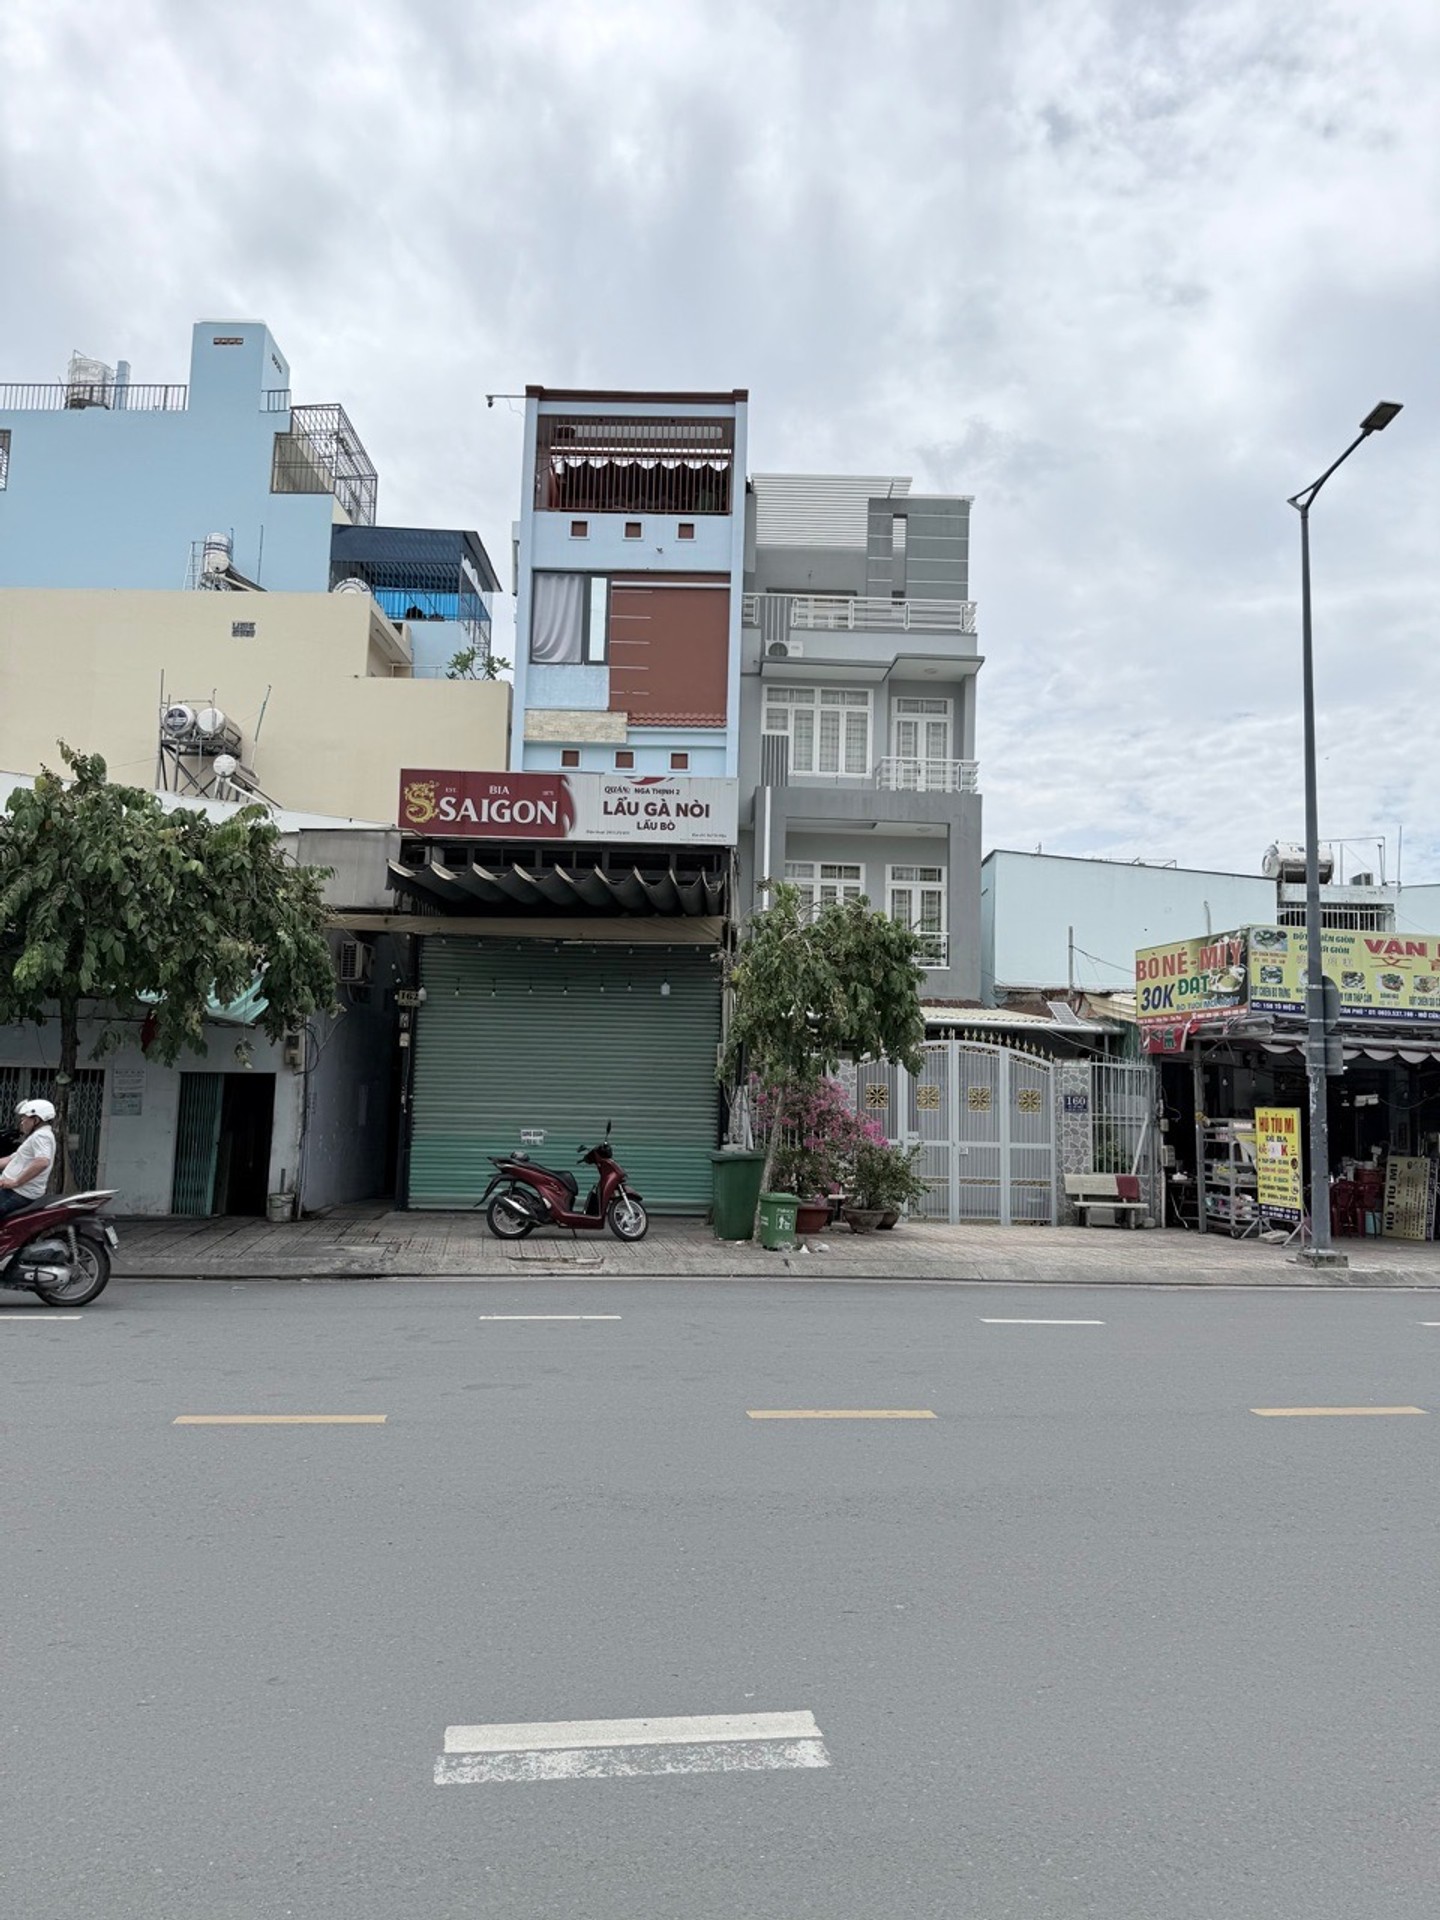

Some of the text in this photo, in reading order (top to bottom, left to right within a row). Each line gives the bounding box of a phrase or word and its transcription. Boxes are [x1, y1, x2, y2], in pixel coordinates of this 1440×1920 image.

[489, 785, 510, 795] BIA
[634, 787, 650, 795] NGA
[439, 796, 558, 825] SAIGON
[644, 798, 671, 817] GÀ
[675, 799, 710, 818] NÒI
[659, 819, 676, 831] BÒ
[1136, 952, 1160, 981] BÒ
[1162, 946, 1188, 977] NÉ
[1141, 983, 1175, 1011] 30K
[1178, 975, 1210, 999] ĐẠT
[1066, 1096, 1086, 1105] 160
